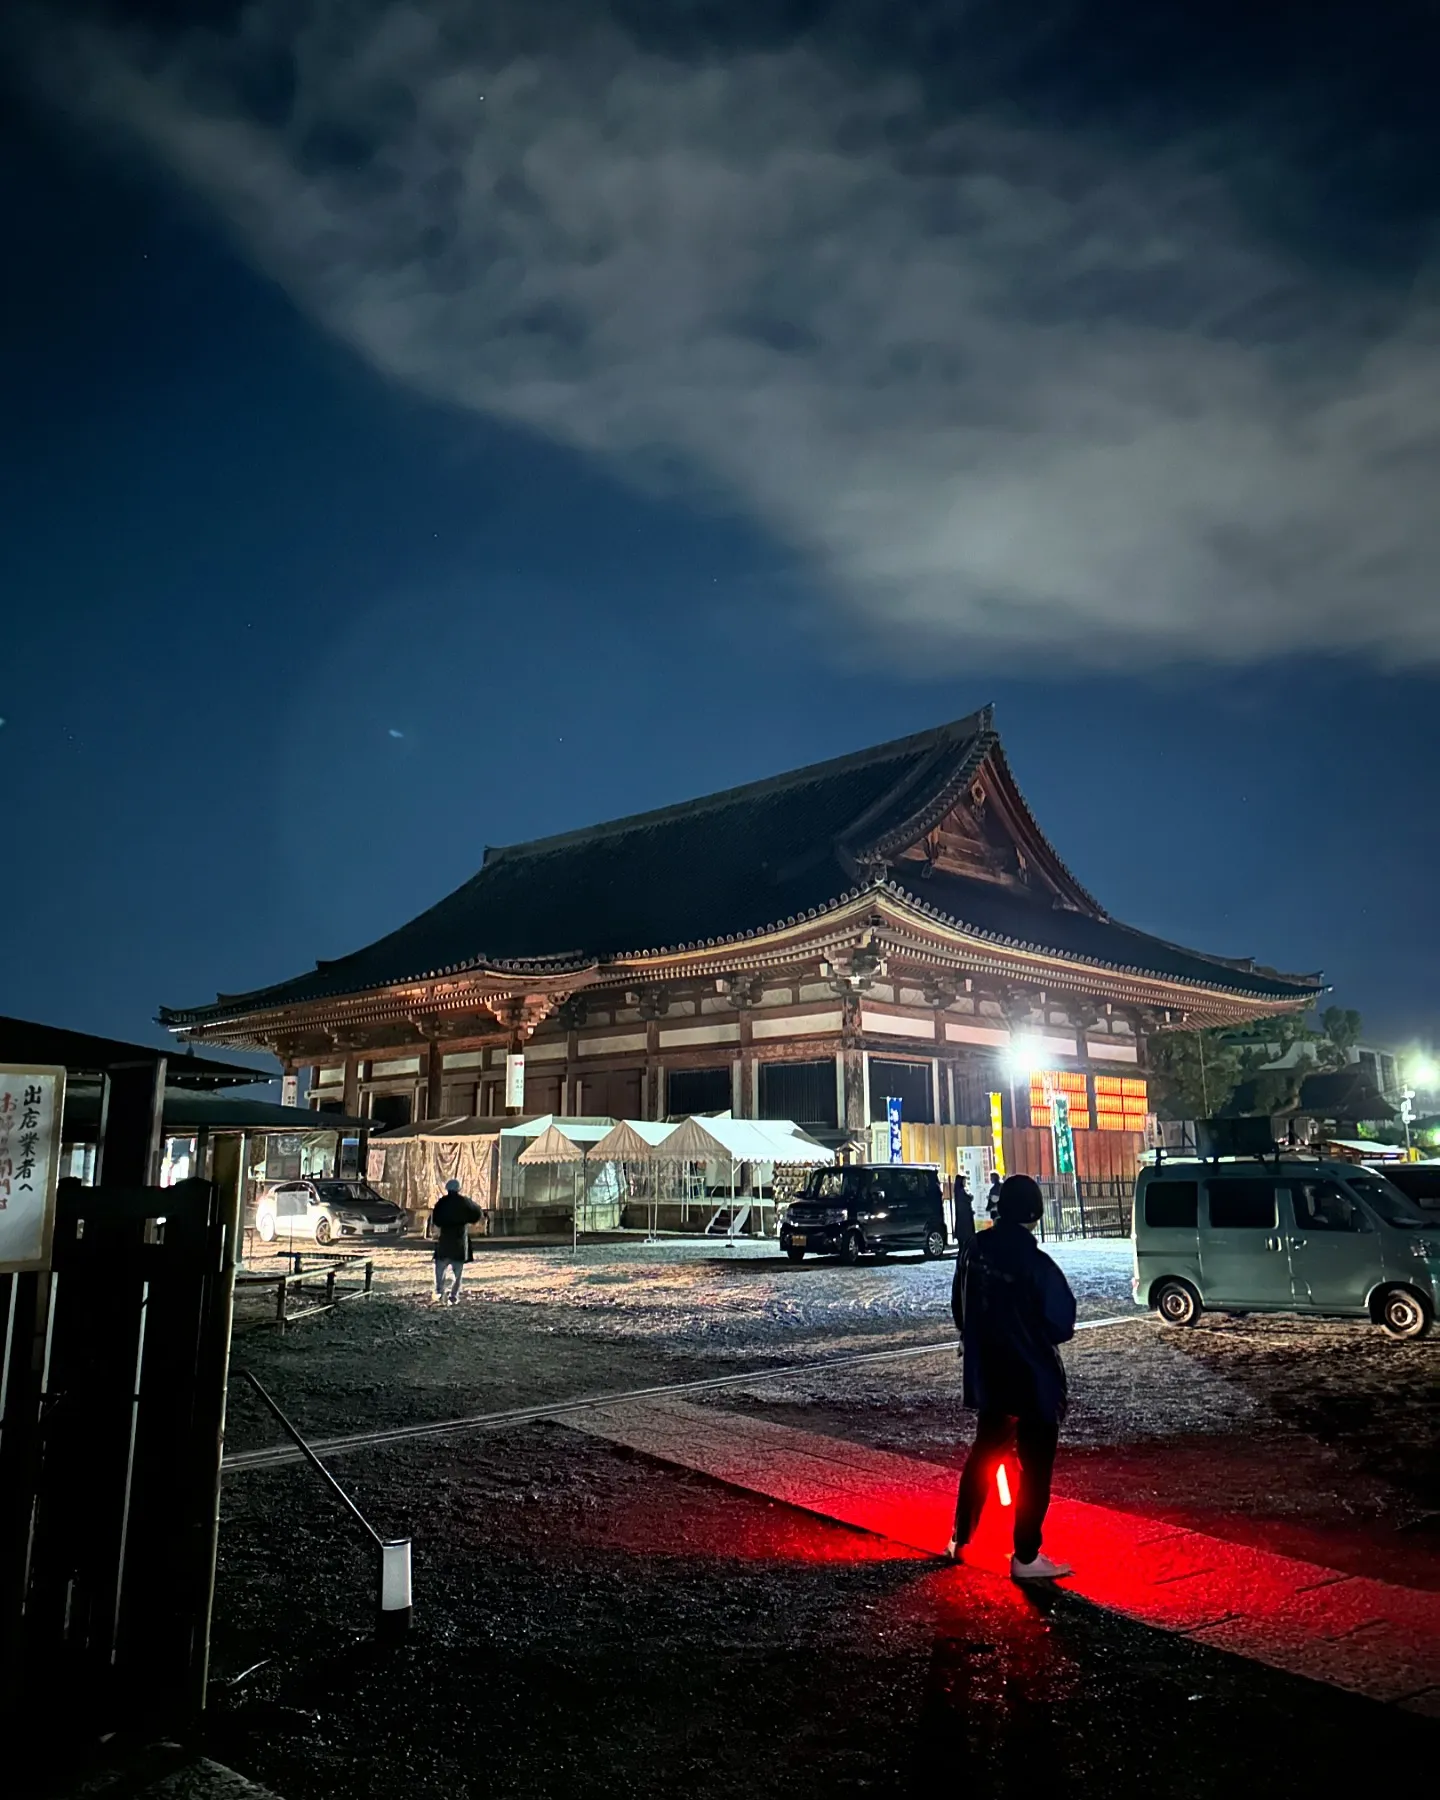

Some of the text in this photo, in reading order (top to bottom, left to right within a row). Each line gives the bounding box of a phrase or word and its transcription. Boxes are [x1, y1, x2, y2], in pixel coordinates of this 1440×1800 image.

[14, 1085, 42, 1191] 出店業者へ
